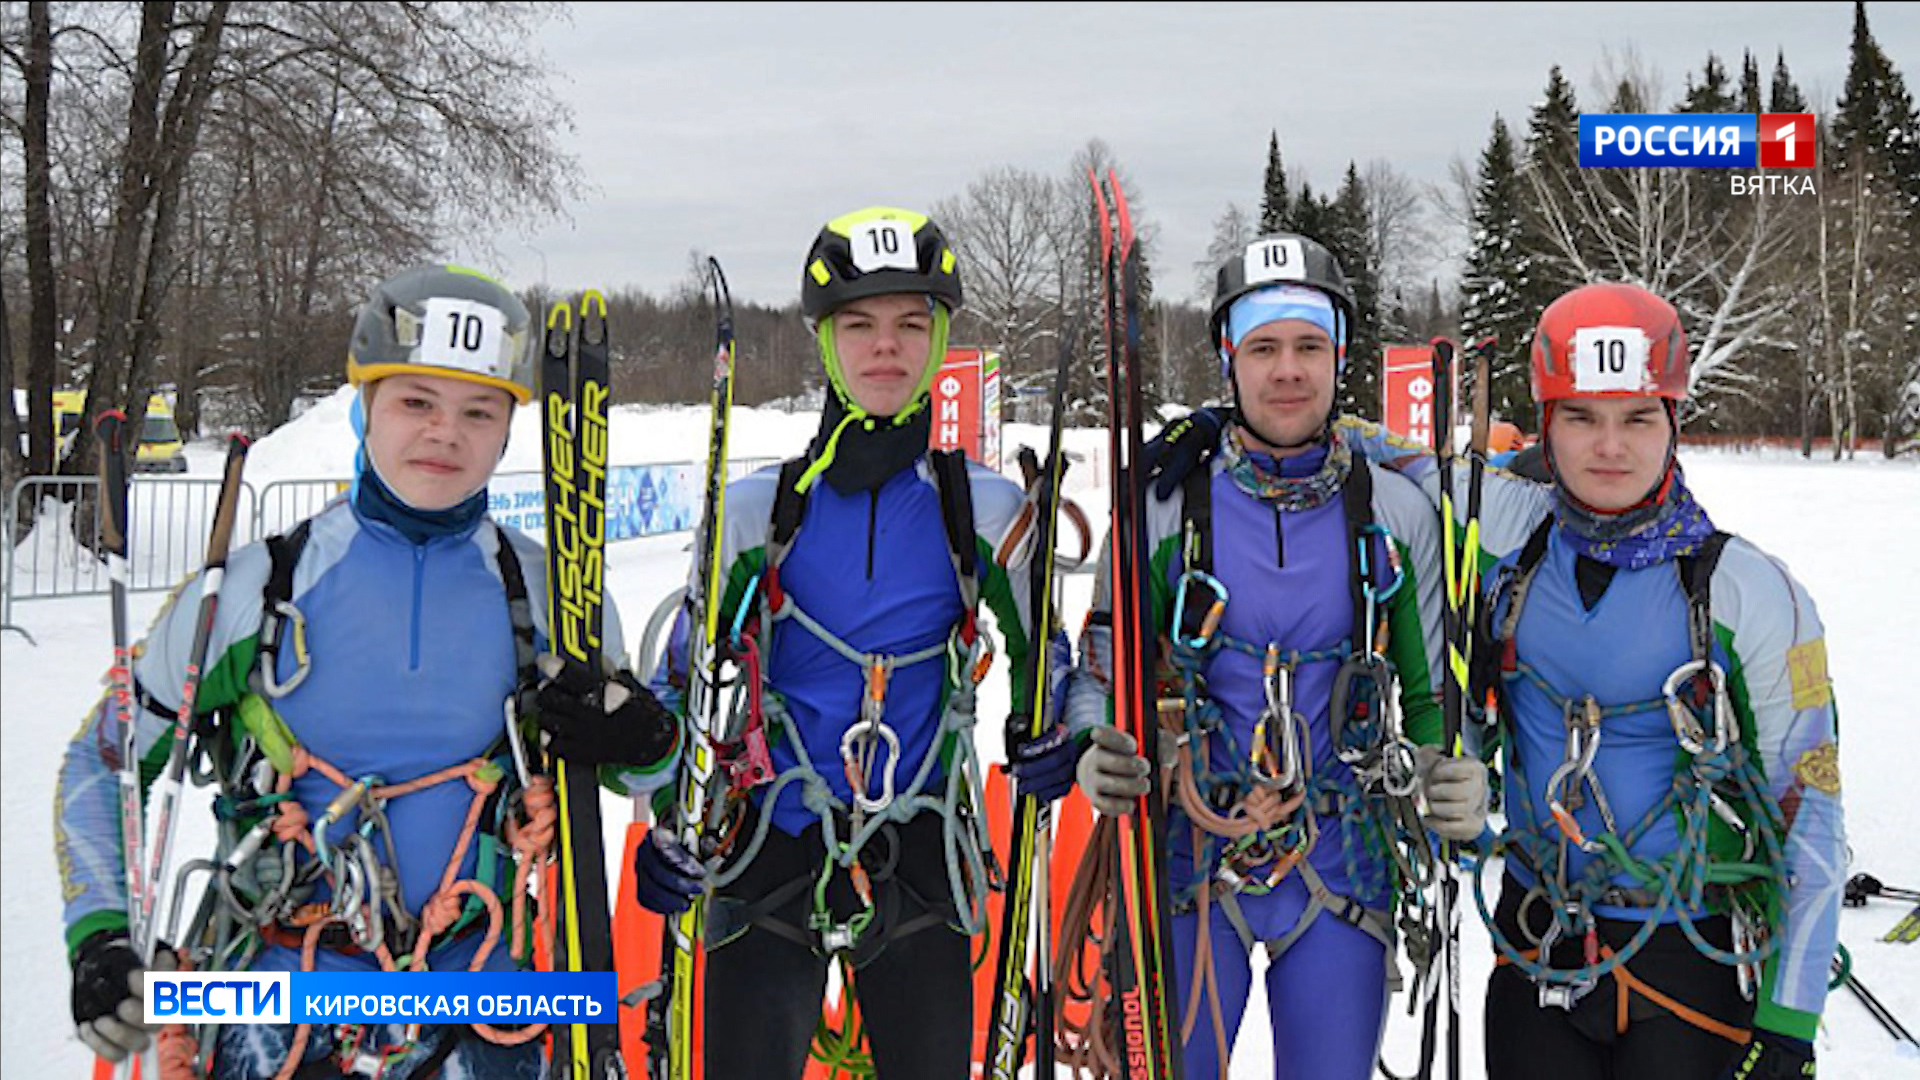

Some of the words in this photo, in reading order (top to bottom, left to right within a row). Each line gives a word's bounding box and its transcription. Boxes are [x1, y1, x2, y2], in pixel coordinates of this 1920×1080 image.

[866, 227, 898, 255] 10
[1261, 244, 1287, 268] 10
[448, 311, 483, 351] 10
[1593, 339, 1625, 374] 10
[548, 391, 588, 662] FISCHER
